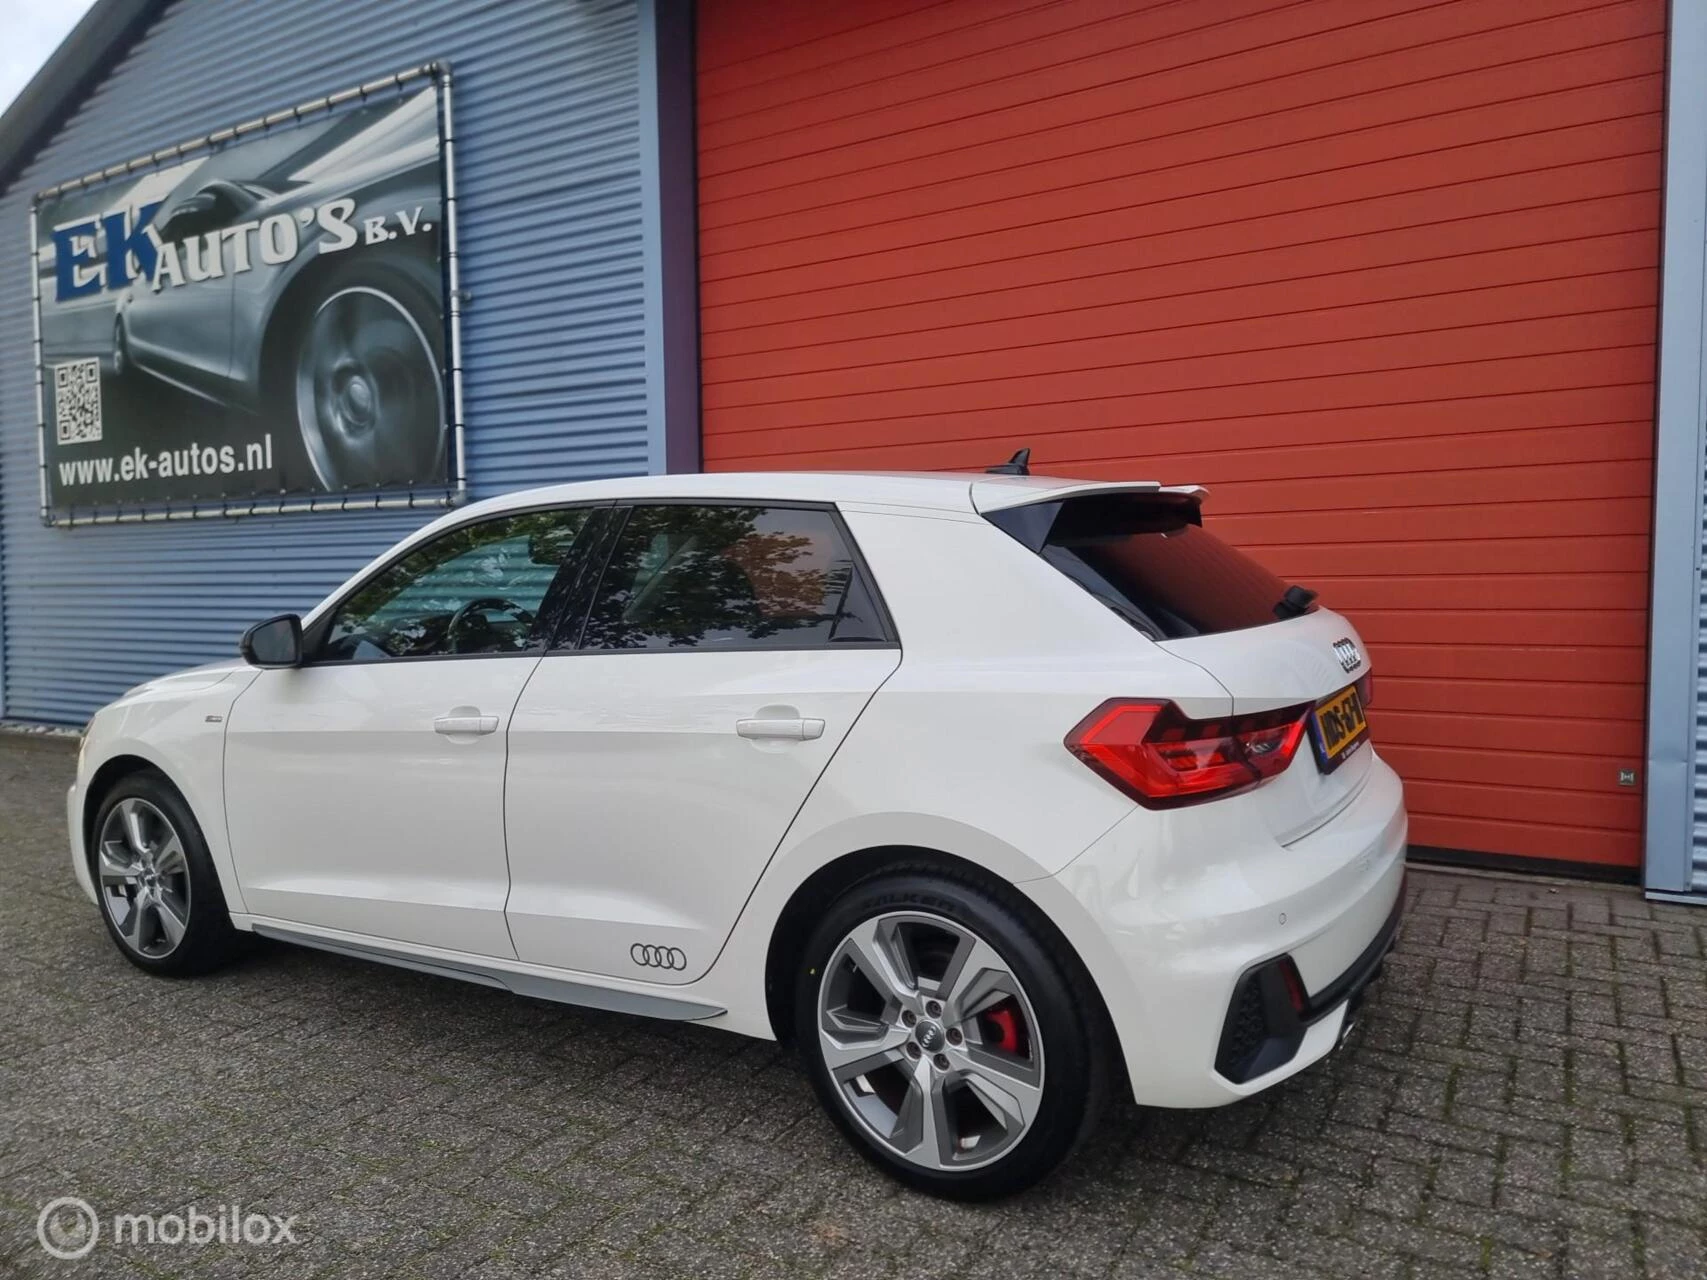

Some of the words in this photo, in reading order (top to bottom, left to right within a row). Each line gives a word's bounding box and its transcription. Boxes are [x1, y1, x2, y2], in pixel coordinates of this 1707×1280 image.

[52, 201, 161, 302] EK
[364, 207, 433, 246] B.V.
[59, 434, 273, 486] www.ek-autos.nl
